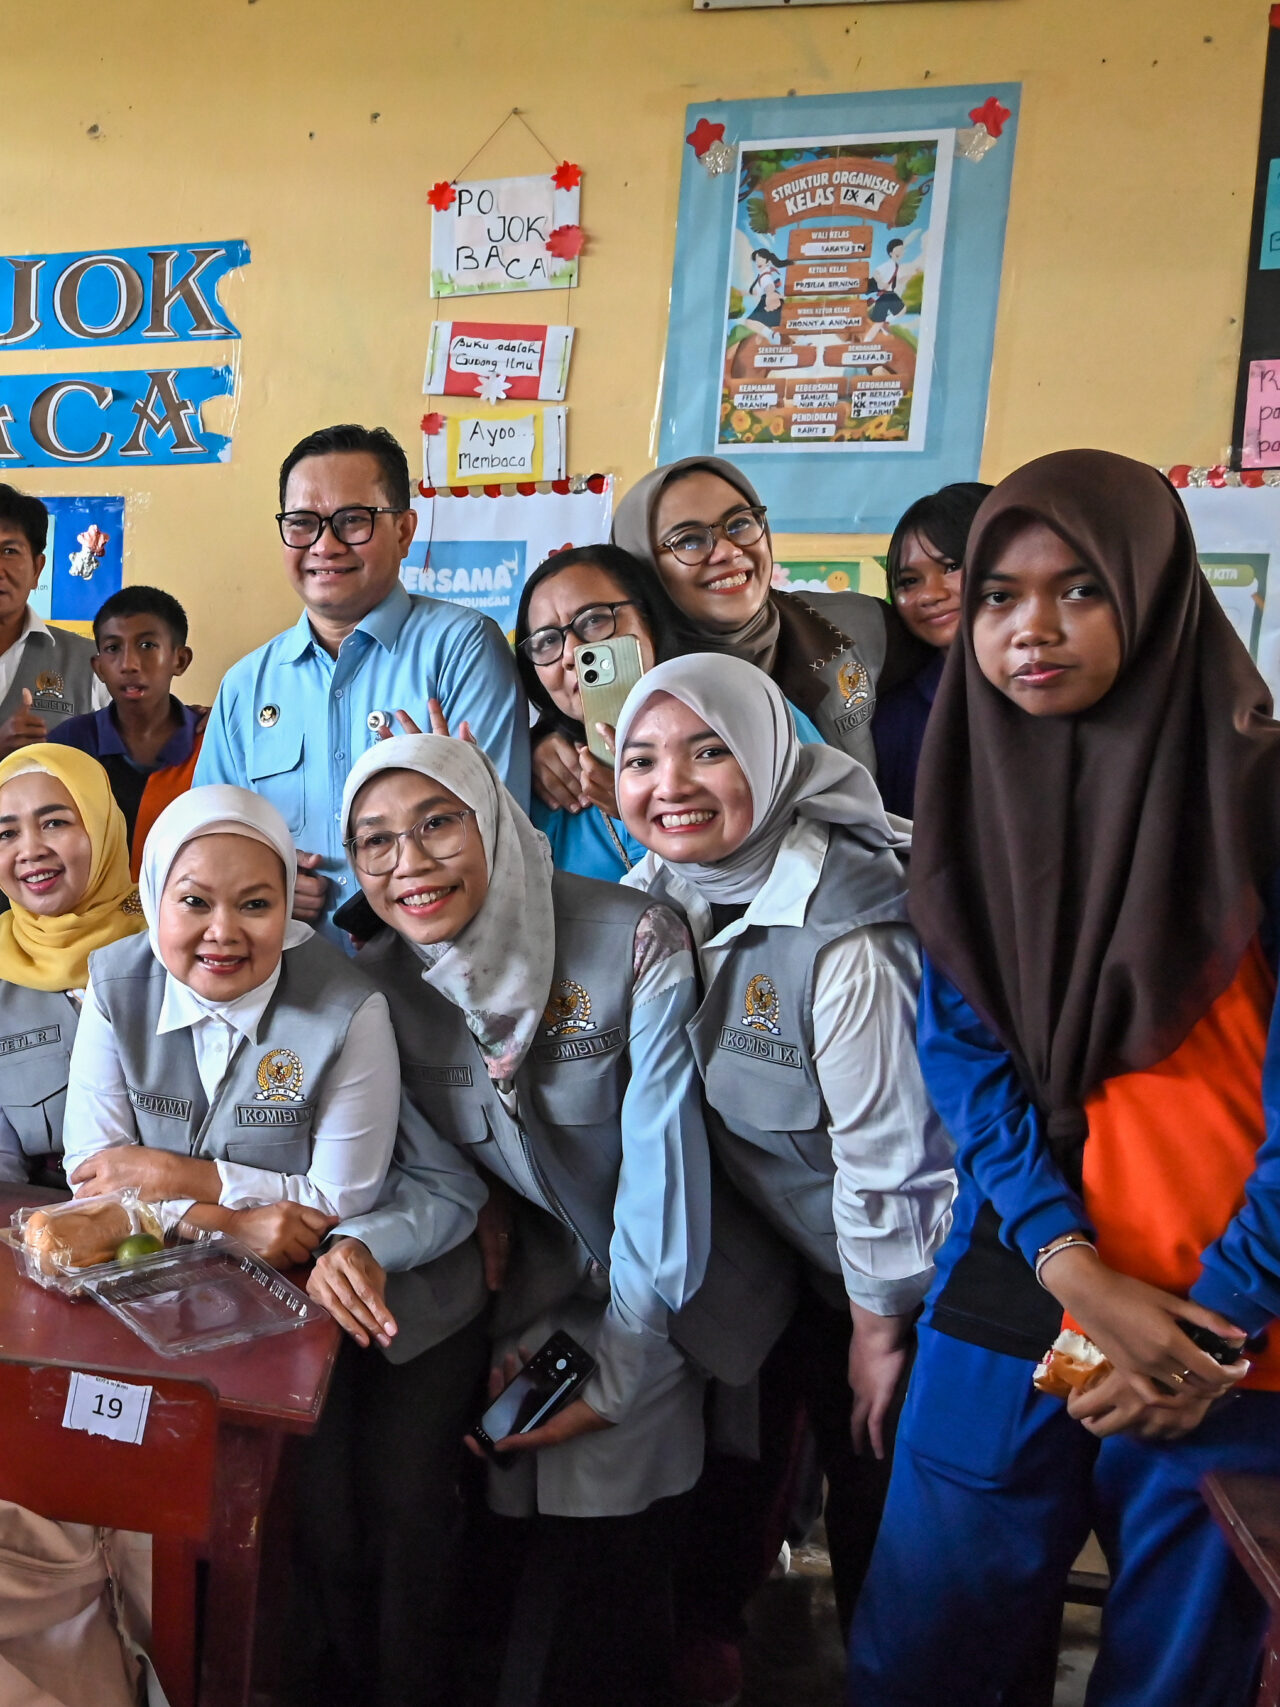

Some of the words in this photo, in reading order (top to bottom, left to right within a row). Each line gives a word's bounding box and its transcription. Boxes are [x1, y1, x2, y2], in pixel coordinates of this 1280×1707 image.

[771, 172, 829, 203] STRUKTUR
[832, 171, 900, 196] ORGANISASI
[457, 190, 494, 217] PO
[785, 187, 835, 216] KELAS
[864, 193, 875, 205] A
[487, 216, 548, 242] JOK
[811, 231, 828, 239] WALI
[829, 230, 850, 238] KELAS
[456, 246, 547, 279] BACA
[829, 265, 848, 273] KELAS
[506, 357, 533, 370] Ilmu
[795, 383, 839, 392] KEBERSIHAN
[853, 400, 866, 408] KK
[792, 412, 838, 422] PENDIDIKAN
[459, 452, 526, 469] Membaca
[38, 1031, 47, 1042] R
[551, 1039, 593, 1058] OMISI
[726, 1032, 774, 1057] KOMISI
[779, 1047, 795, 1062] IX
[92, 1394, 123, 1419] 19
